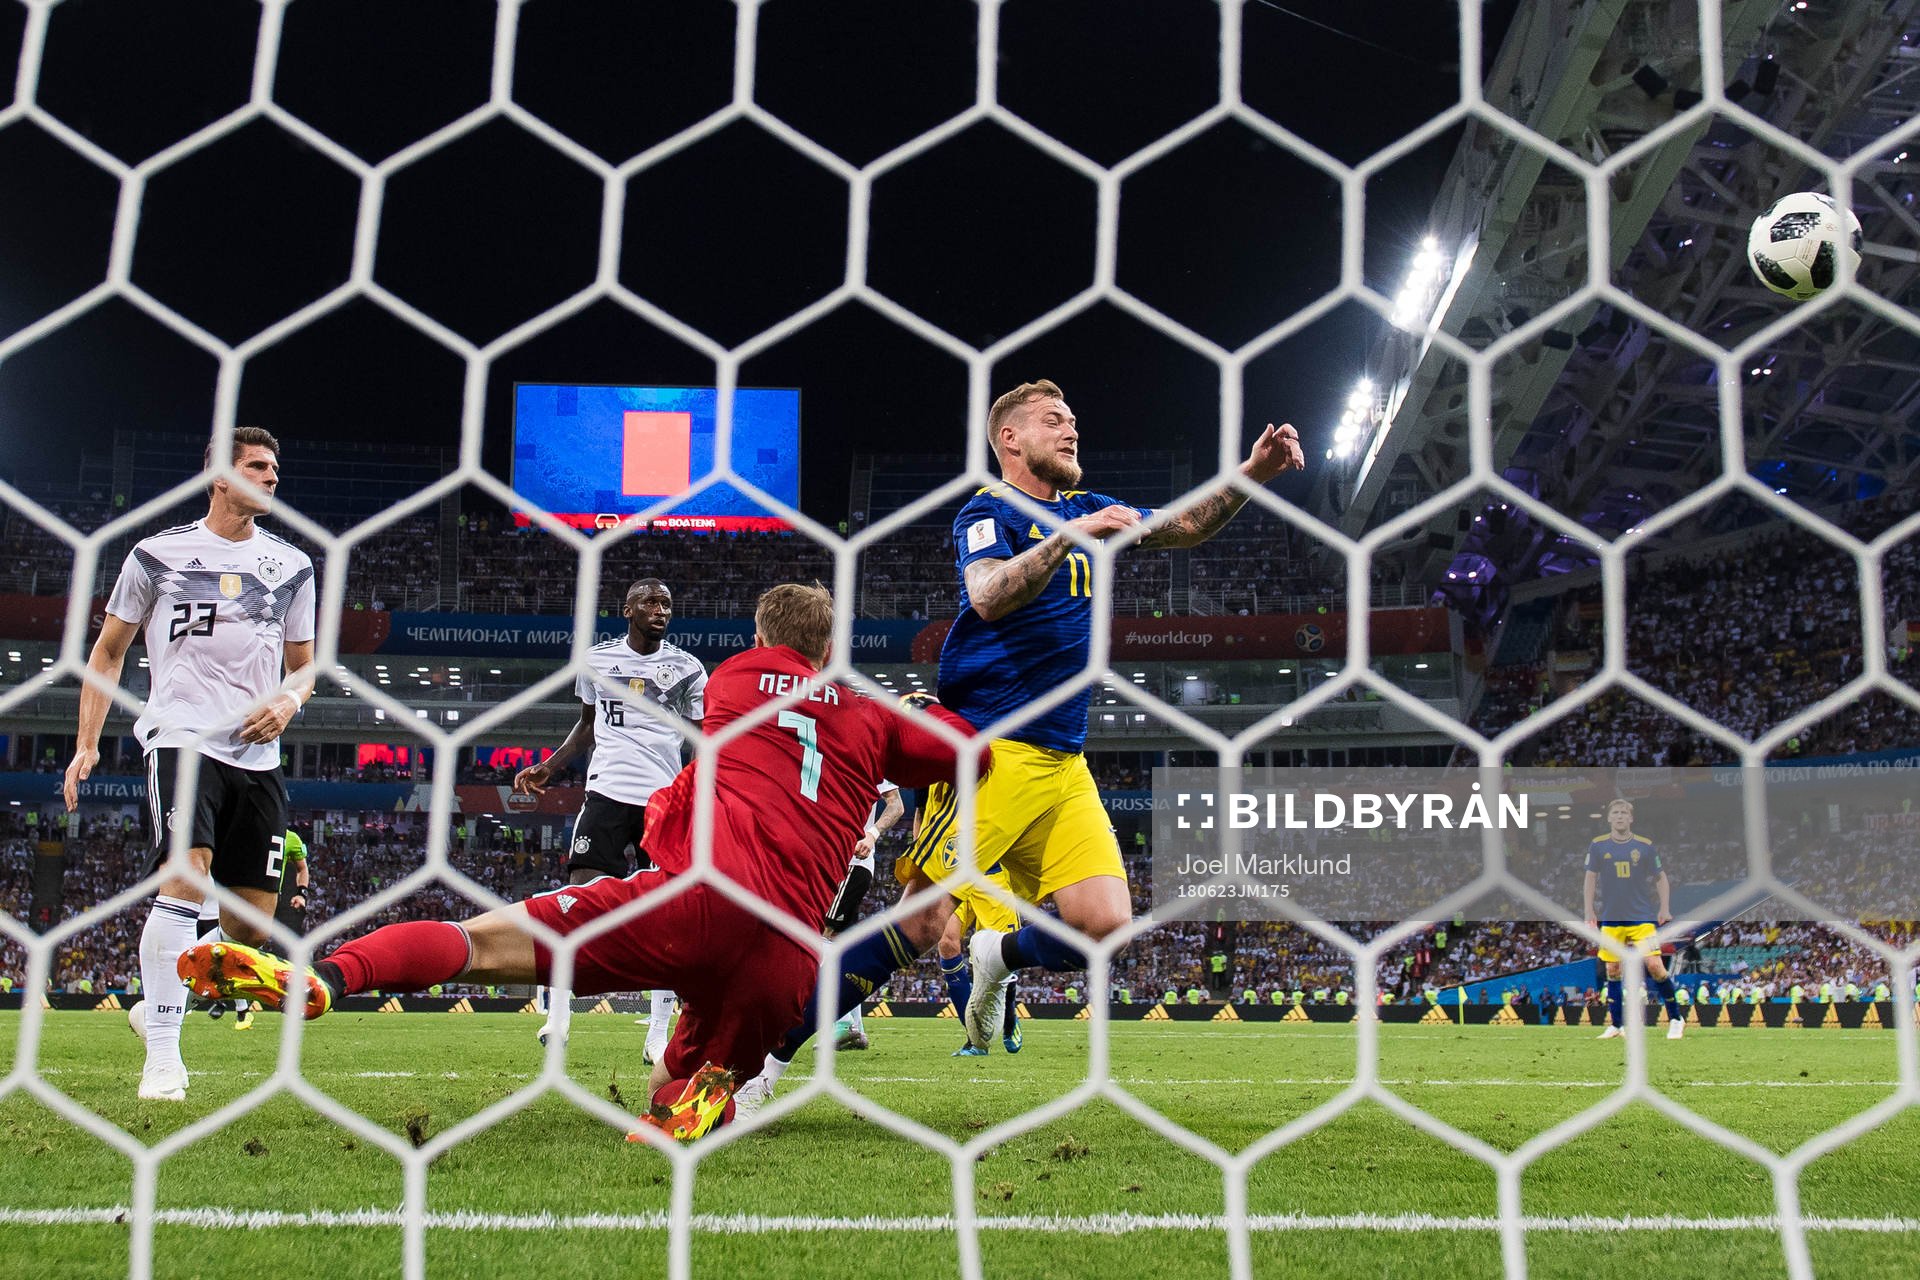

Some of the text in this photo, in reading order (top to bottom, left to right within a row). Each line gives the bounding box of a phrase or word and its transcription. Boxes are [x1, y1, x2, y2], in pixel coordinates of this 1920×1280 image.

[669, 518, 716, 528] BOATENG
[1066, 551, 1092, 598] 11
[169, 603, 217, 643] 23
[407, 627, 522, 644] ЧЕМПИОНАТ
[708, 633, 745, 648] FIFA
[1125, 630, 1213, 648] #worldcup
[600, 700, 625, 727] 16
[94, 783, 129, 797] FIFA
[1111, 798, 1171, 811] RUSSIA
[1613, 861, 1631, 879] 10
